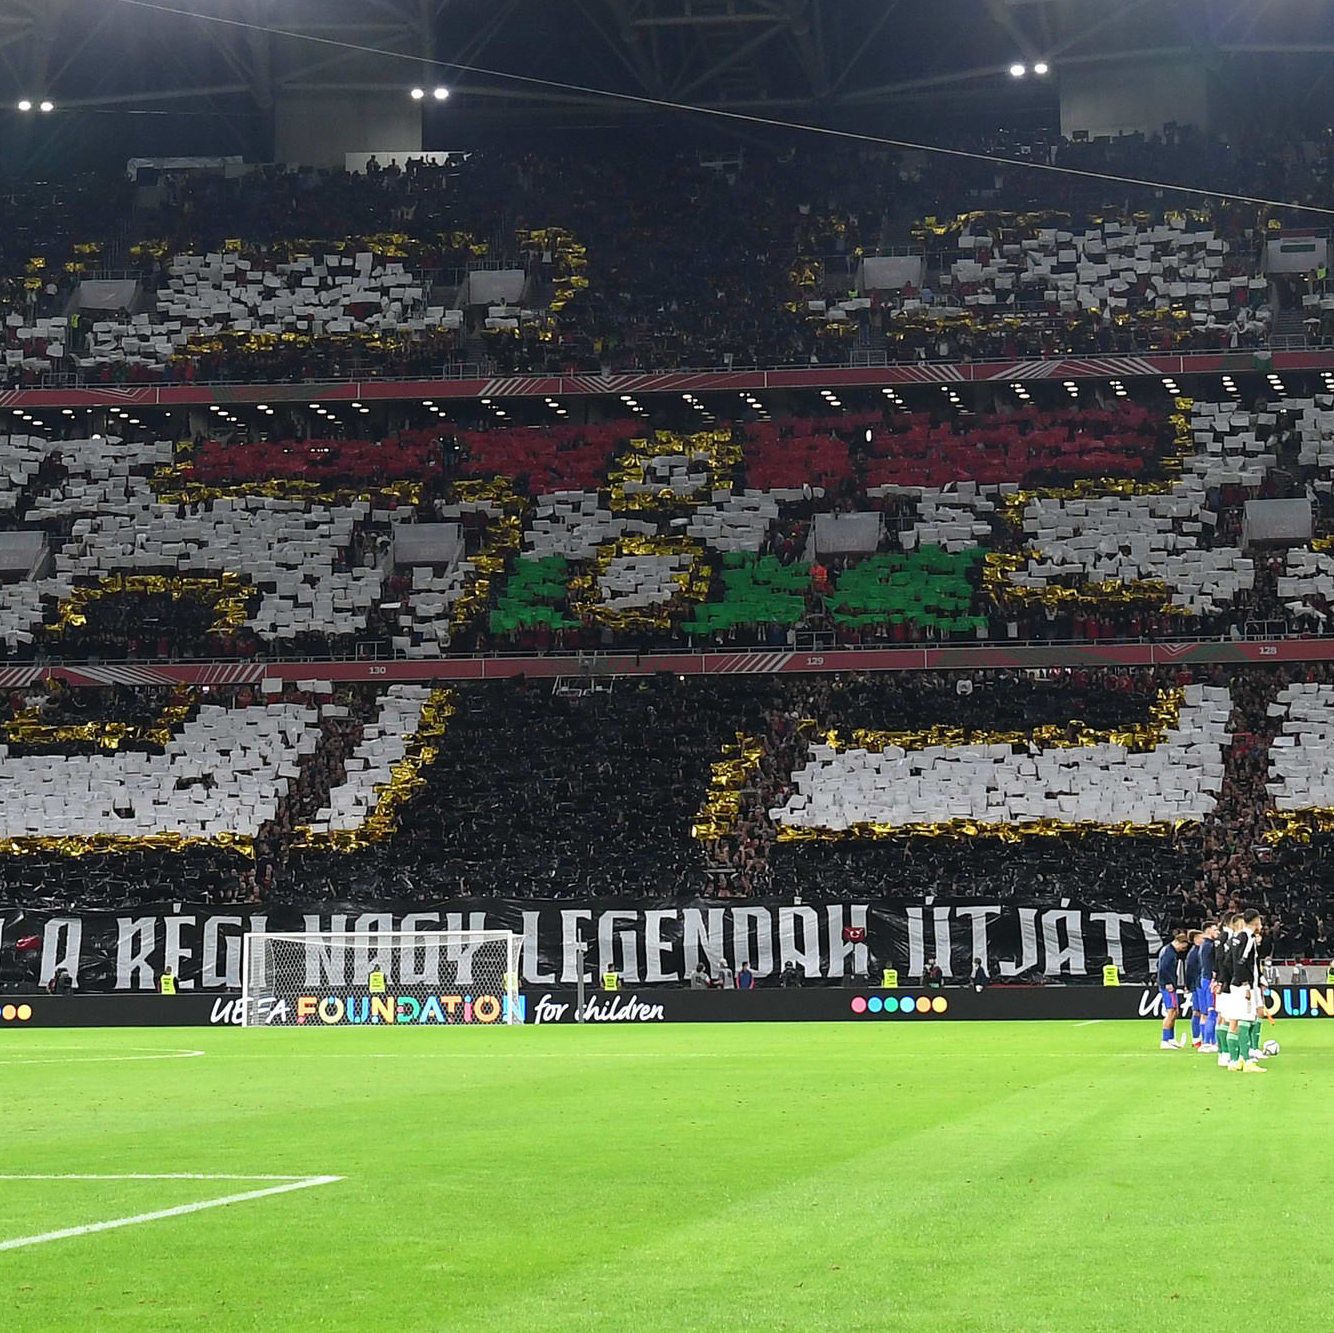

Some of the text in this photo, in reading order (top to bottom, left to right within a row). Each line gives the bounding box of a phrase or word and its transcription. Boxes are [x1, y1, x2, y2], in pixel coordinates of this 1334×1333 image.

[1258, 646, 1277, 655] 128
[806, 658, 824, 666] 129
[369, 667, 386, 675] 130
[38, 915, 82, 988] A
[116, 903, 267, 988] RÉGI
[303, 911, 487, 986] NAGY
[522, 897, 868, 984] LEGENDÁK
[210, 997, 290, 1024] UEFA
[296, 995, 526, 1024] FOUNDATION
[534, 994, 569, 1024] for
